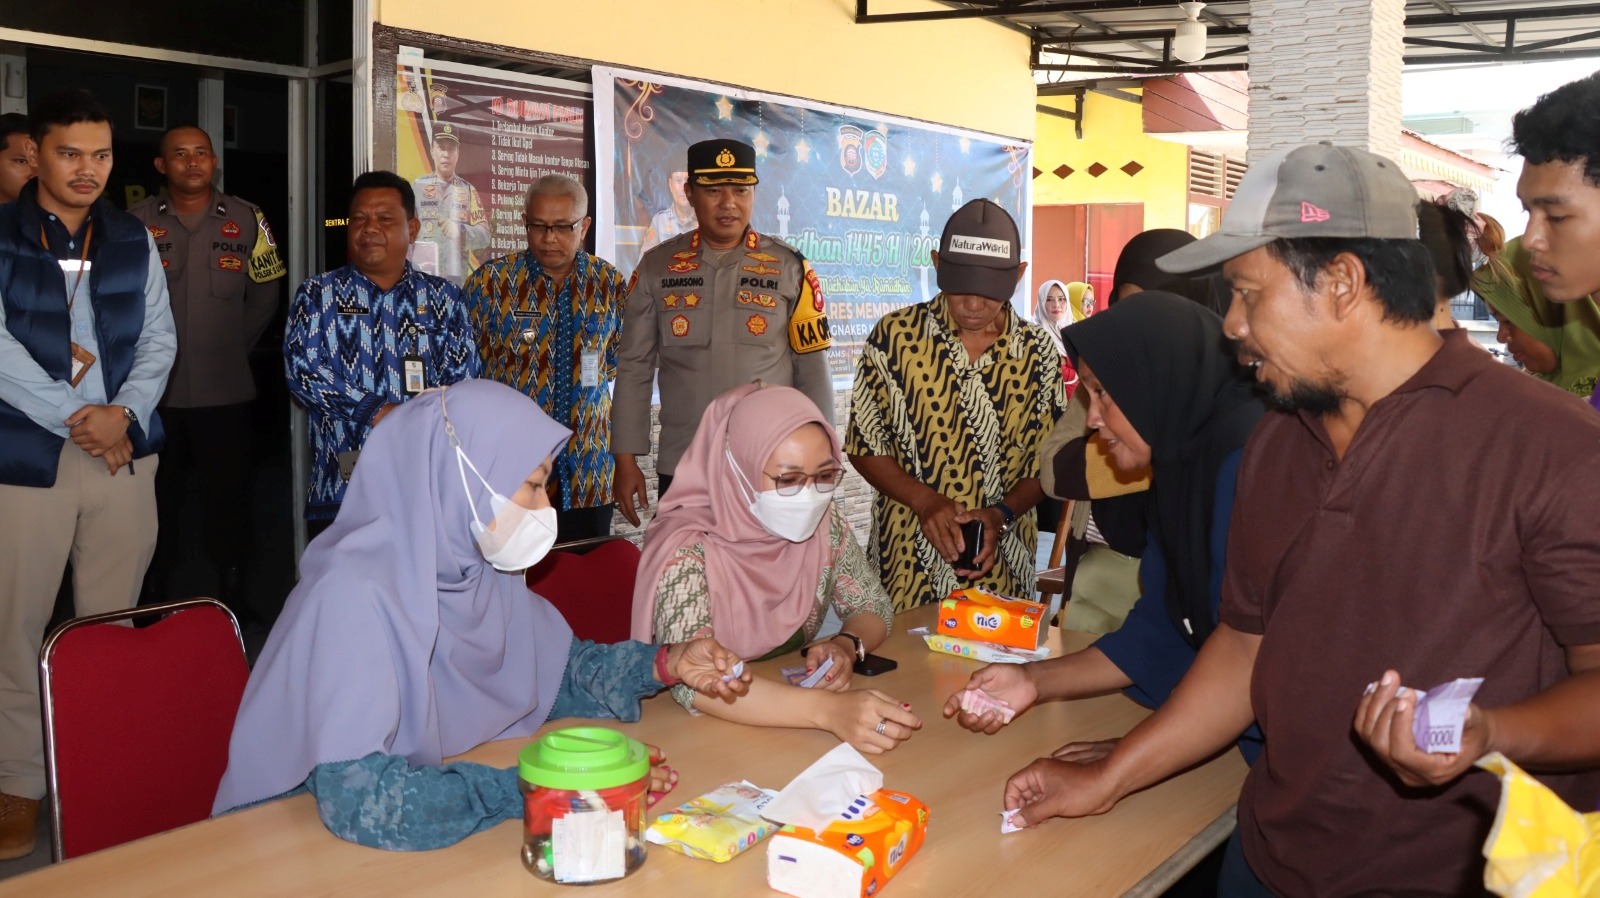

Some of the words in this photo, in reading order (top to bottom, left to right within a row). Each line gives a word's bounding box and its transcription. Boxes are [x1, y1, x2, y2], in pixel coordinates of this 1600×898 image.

[522, 124, 538, 135] Masuk
[498, 136, 511, 147] Tidak
[498, 150, 514, 164] Sering
[515, 152, 528, 163] Tidak
[529, 153, 544, 164] Masuk
[498, 165, 514, 178] Sering
[826, 187, 899, 222] BAZAR
[325, 219, 345, 227] SENTRA
[212, 241, 247, 254] POLRI
[846, 232, 883, 265] 1445
[251, 250, 277, 271] KANIT
[661, 277, 704, 288] SUDARSONO
[740, 278, 778, 290] POLRI
[797, 322, 818, 347] KA
[831, 324, 868, 337] GNAKER
[1423, 730, 1455, 746] 10000
